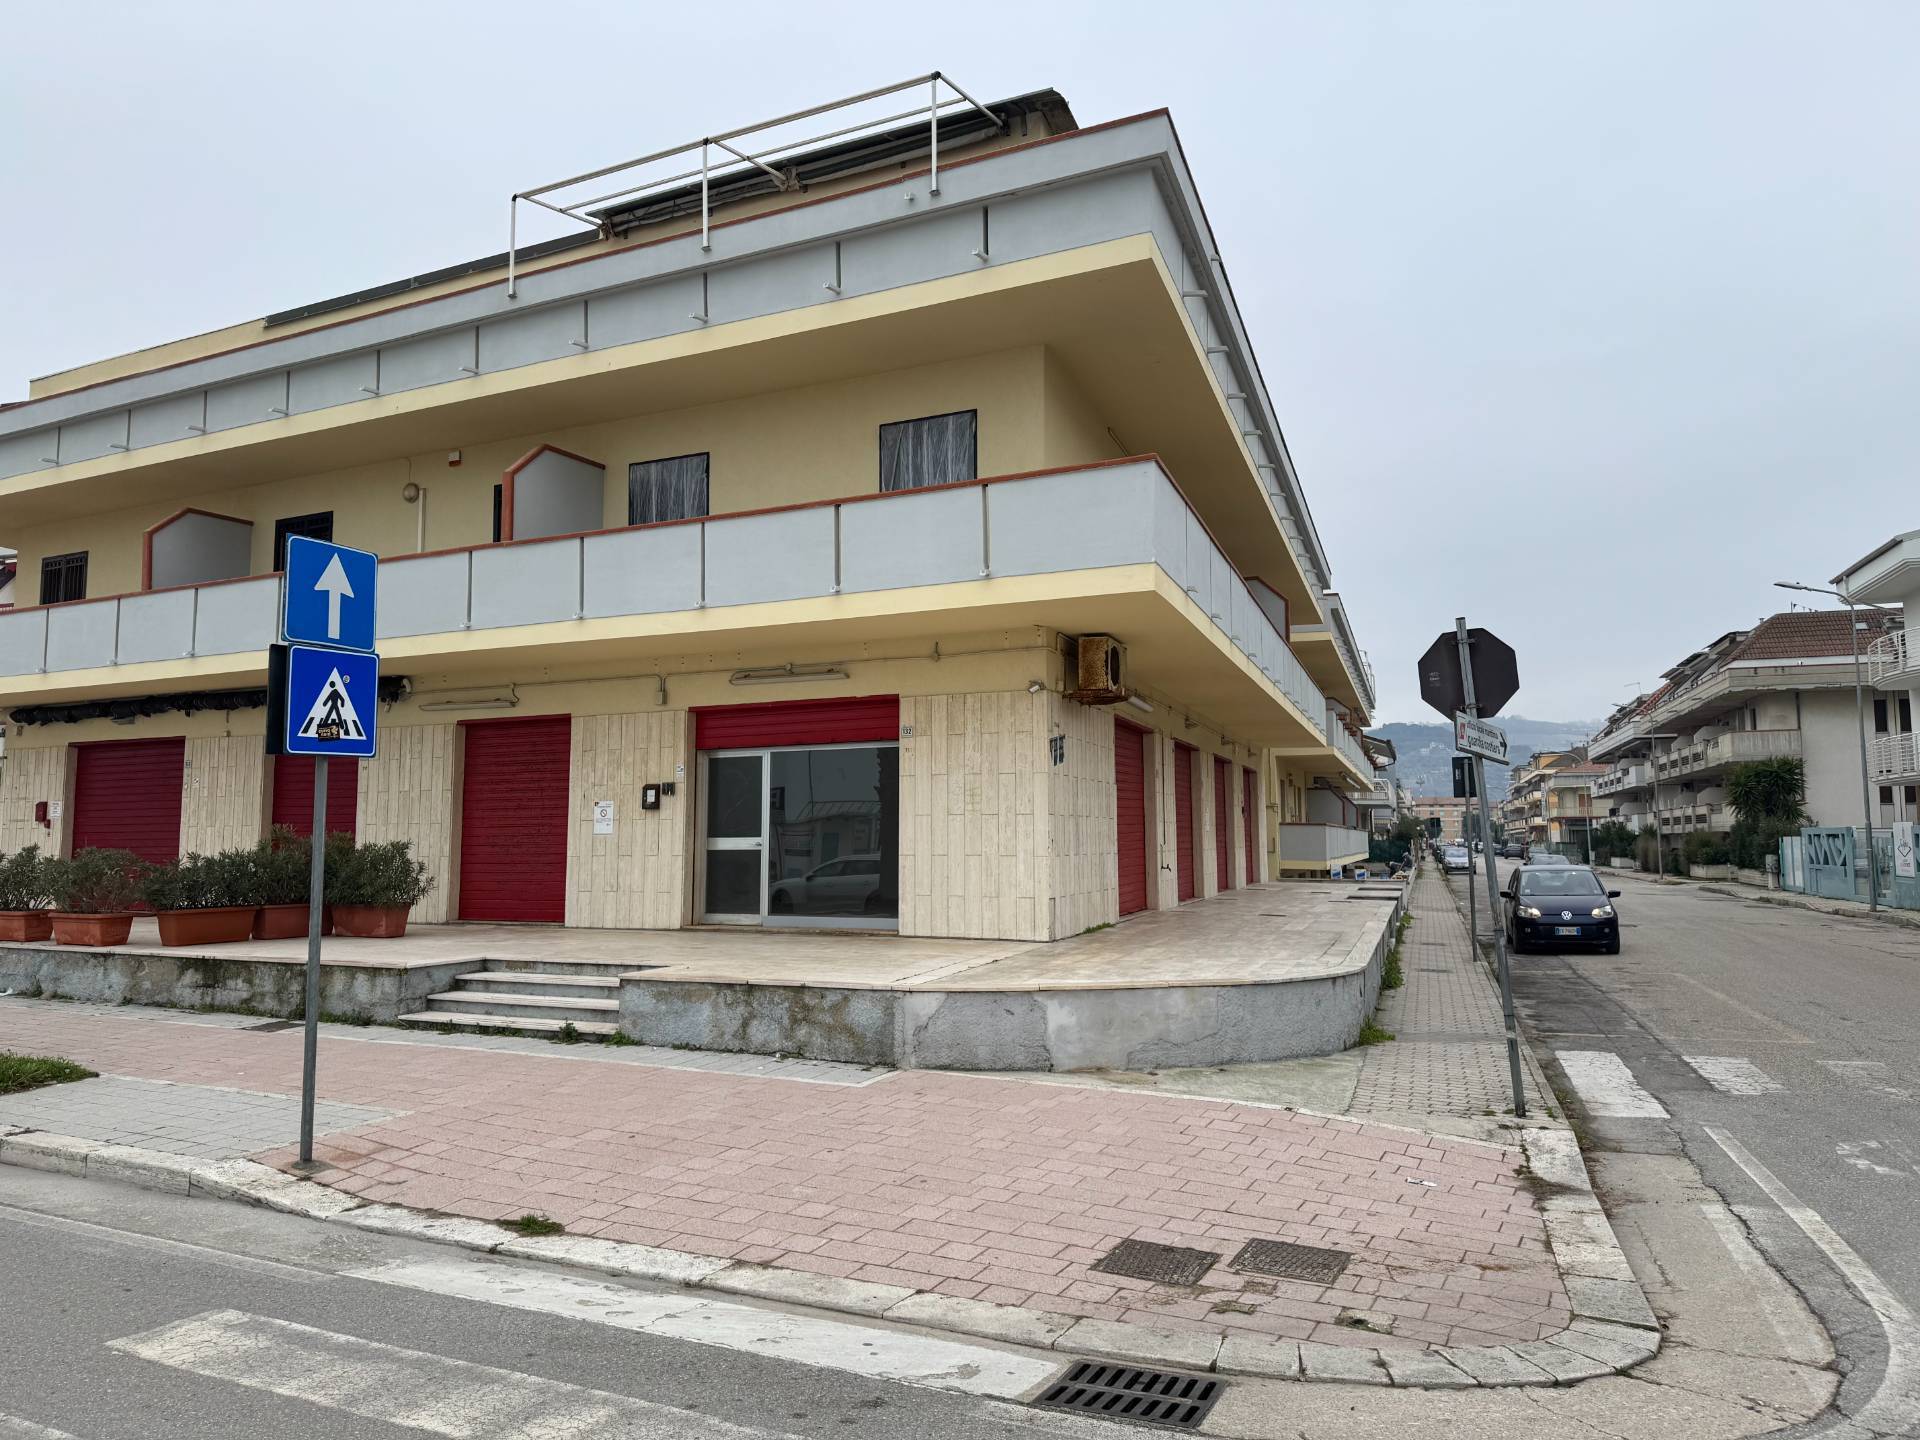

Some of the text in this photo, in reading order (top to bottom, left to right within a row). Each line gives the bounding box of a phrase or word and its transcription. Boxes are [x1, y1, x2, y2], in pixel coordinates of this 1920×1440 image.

[902, 727, 911, 735] 132
[1468, 735, 1500, 754] guardia costiera
